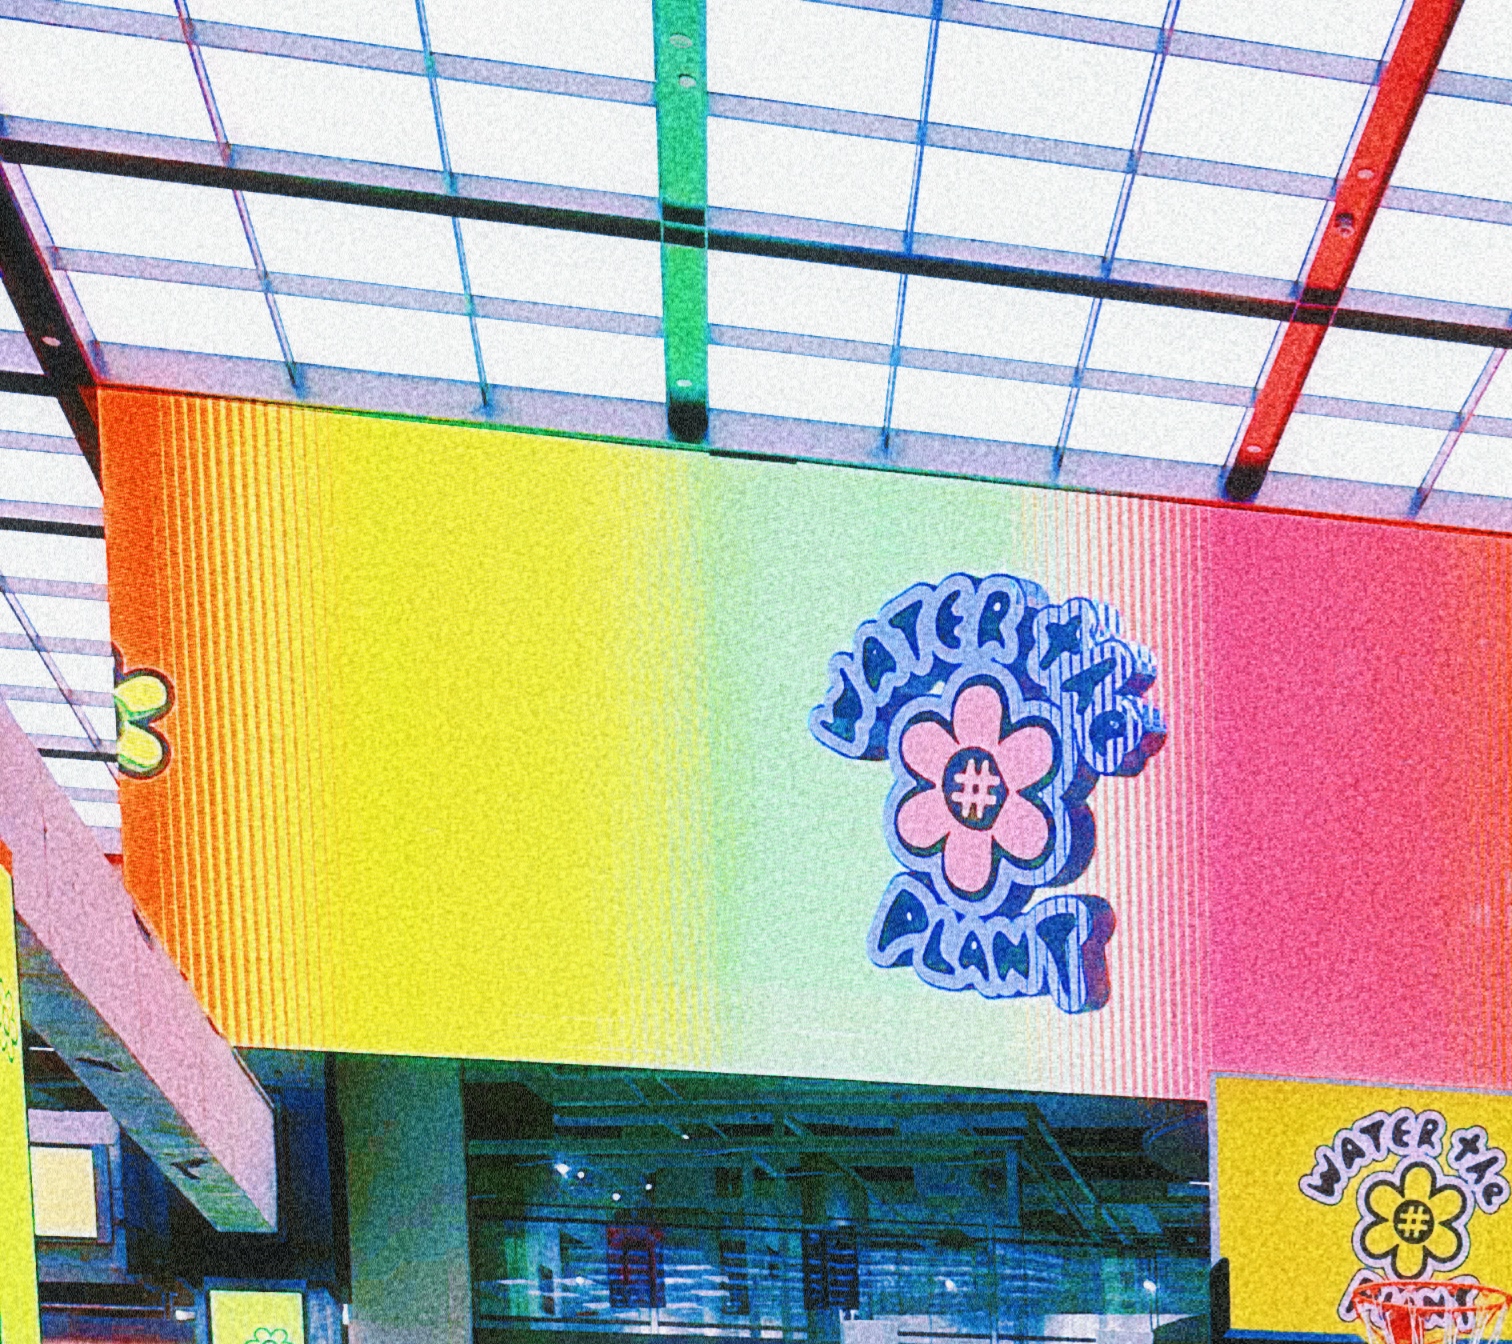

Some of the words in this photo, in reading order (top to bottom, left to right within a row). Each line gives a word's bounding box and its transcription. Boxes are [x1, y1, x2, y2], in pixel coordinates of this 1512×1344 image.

[809, 573, 1035, 760] WATER
[866, 870, 1114, 1015] PLANT
[1299, 1107, 1446, 1204] WATER
